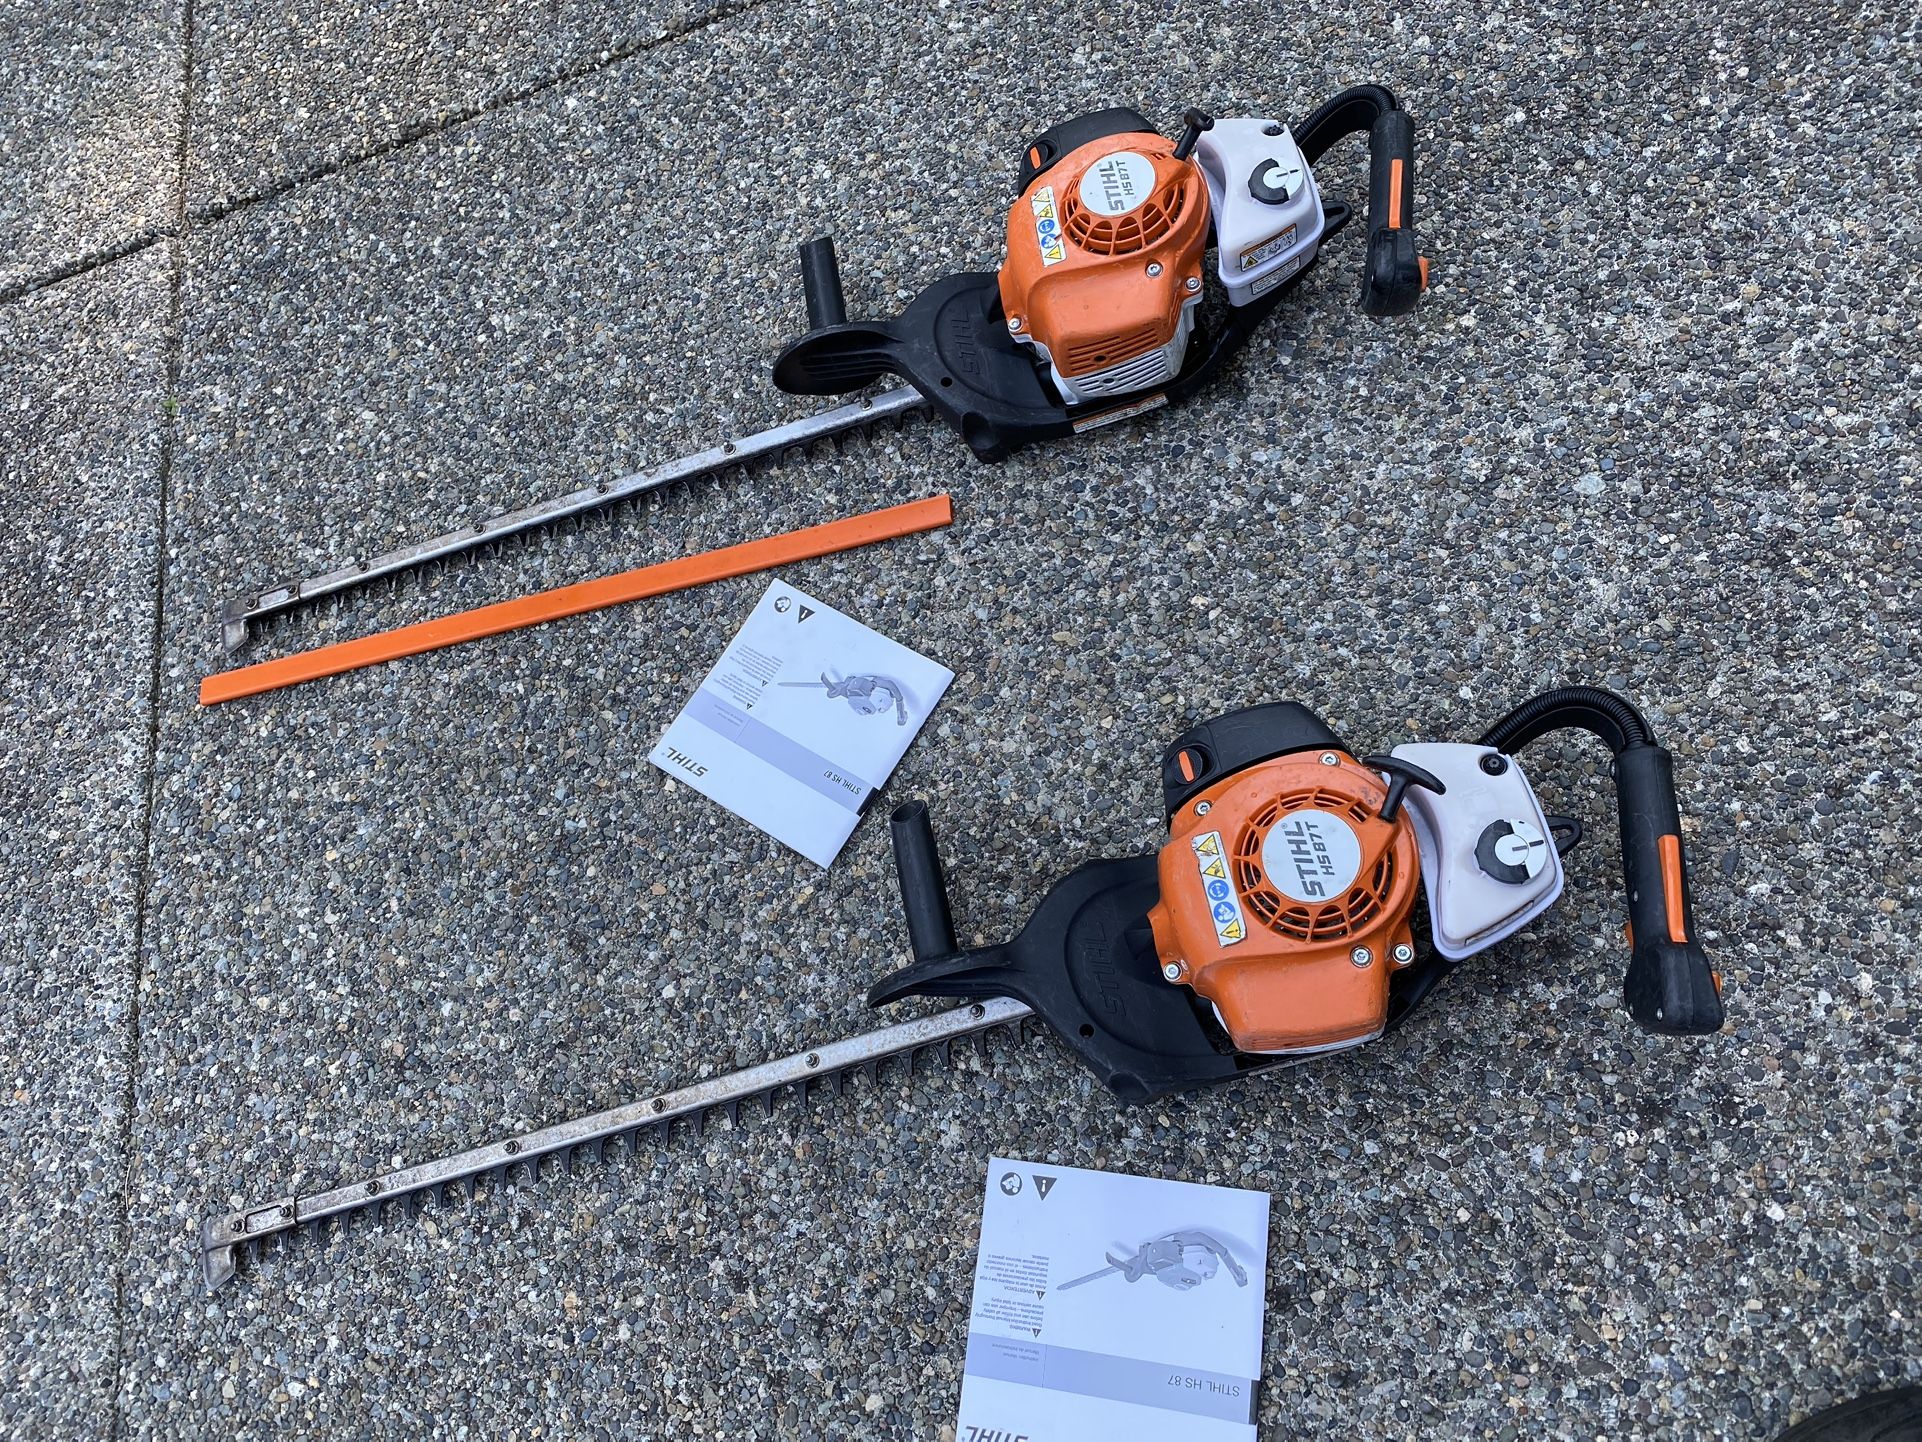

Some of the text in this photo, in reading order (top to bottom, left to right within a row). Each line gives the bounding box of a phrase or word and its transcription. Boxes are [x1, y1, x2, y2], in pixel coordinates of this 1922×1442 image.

[1099, 161, 1125, 210] STIHL
[1121, 181, 1134, 196] HS
[951, 309, 981, 376] STIHL
[667, 747, 708, 777] STIHL
[823, 769, 862, 795] STIHL HS 87
[1284, 821, 1326, 896] STIHL
[1304, 821, 1335, 875] HS 87T
[1168, 1375, 1240, 1397] STIHL HS 87
